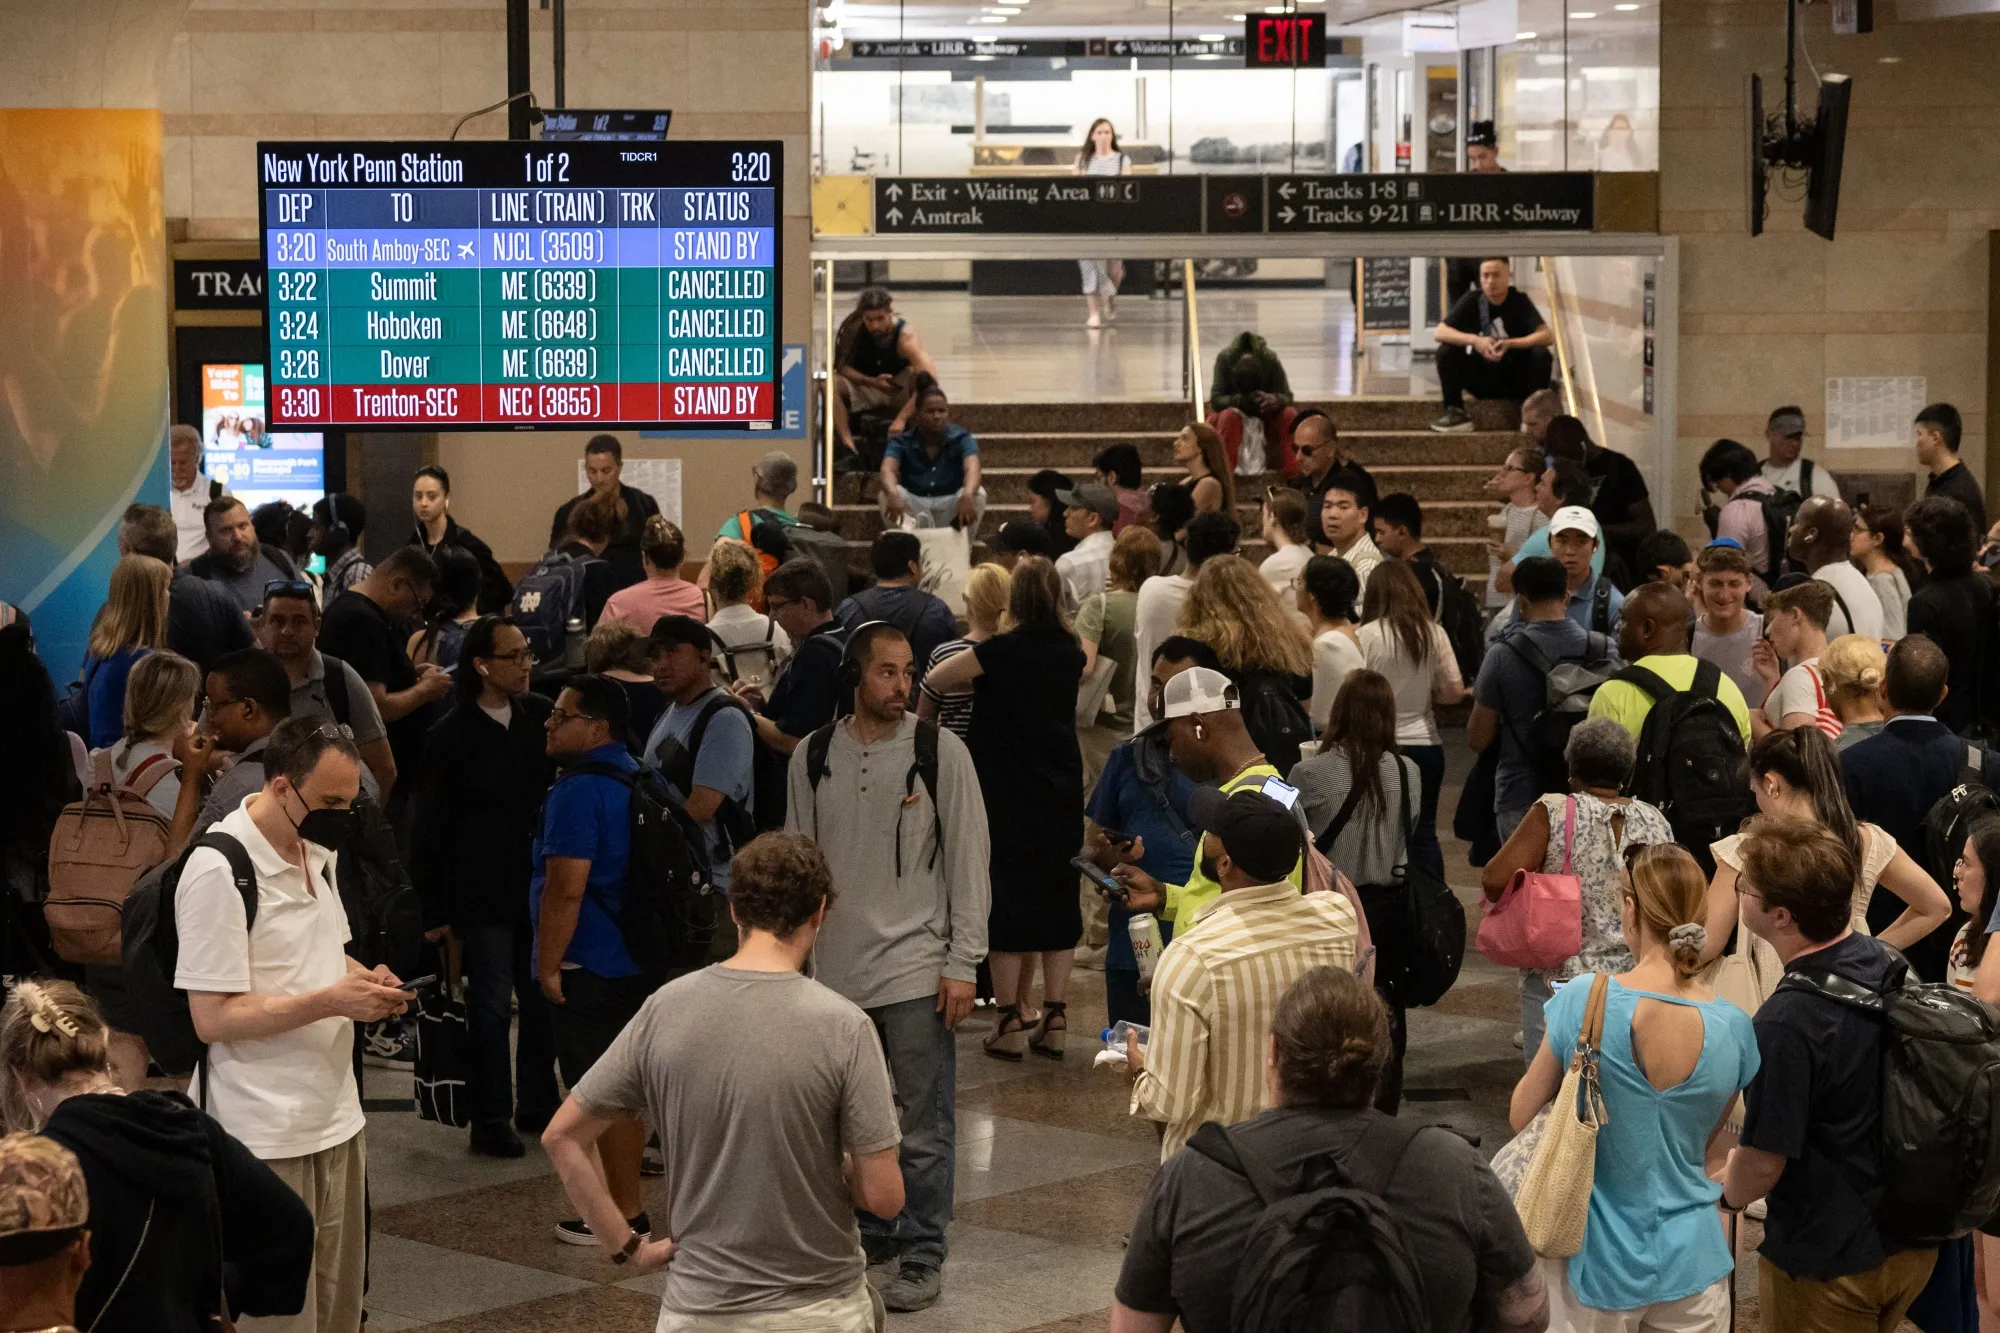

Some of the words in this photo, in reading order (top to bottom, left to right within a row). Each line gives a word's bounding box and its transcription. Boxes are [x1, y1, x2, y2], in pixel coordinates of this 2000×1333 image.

[1257, 18, 1313, 62] EXIT
[264, 153, 303, 183] New
[307, 153, 349, 183] York
[353, 153, 397, 183] Penn
[401, 152, 463, 183] Station
[523, 152, 532, 182] 1
[536, 152, 554, 182] of
[558, 152, 570, 182] 2
[619, 152, 658, 162] TIDCR1
[732, 152, 771, 182] 3:20
[911, 182, 947, 200] Exit
[966, 182, 1039, 205] Waiting
[1045, 182, 1090, 200] Area
[1302, 182, 1363, 200] Tracks
[278, 193, 313, 223] DEP
[390, 192, 413, 223] TO
[491, 192, 530, 222] LINE
[535, 189, 605, 224] (TRAIN)
[620, 191, 656, 222] TRK
[684, 191, 750, 222] STATUS
[910, 206, 984, 226] Amtrak
[1302, 205, 1363, 224] Tracks
[1369, 204, 1408, 223] 9-21
[1449, 204, 1500, 222] LIRR
[1512, 203, 1581, 223] Subway
[276, 232, 316, 262] 3:20
[327, 238, 368, 262] South
[371, 237, 450, 265] Amboy-SEC
[493, 231, 535, 261] NJCL
[540, 229, 605, 264] (3509)
[674, 231, 731, 261] STAND
[736, 231, 761, 260] BY
[191, 271, 262, 296] TRA
[278, 271, 317, 301] 3:22
[371, 271, 438, 301] Summit
[501, 271, 528, 300] ME
[534, 268, 596, 303] (6339)
[667, 270, 765, 301] CANCELLED
[279, 310, 319, 340] 3:24
[367, 310, 442, 340] Hoboken
[501, 310, 528, 339] ME
[534, 307, 597, 342] (6648)
[667, 309, 765, 339] CANCELLED
[280, 349, 319, 379] 3:26
[380, 349, 430, 379] Dover
[502, 349, 529, 378] ME
[535, 346, 597, 380] (6639)
[667, 347, 765, 377] CANCELLED
[281, 388, 320, 418] 3:30
[353, 387, 458, 417] Trenton-SEC
[499, 387, 533, 416] NEC
[538, 384, 601, 418] (3855)
[674, 386, 731, 415] STAND
[735, 386, 759, 415] BY
